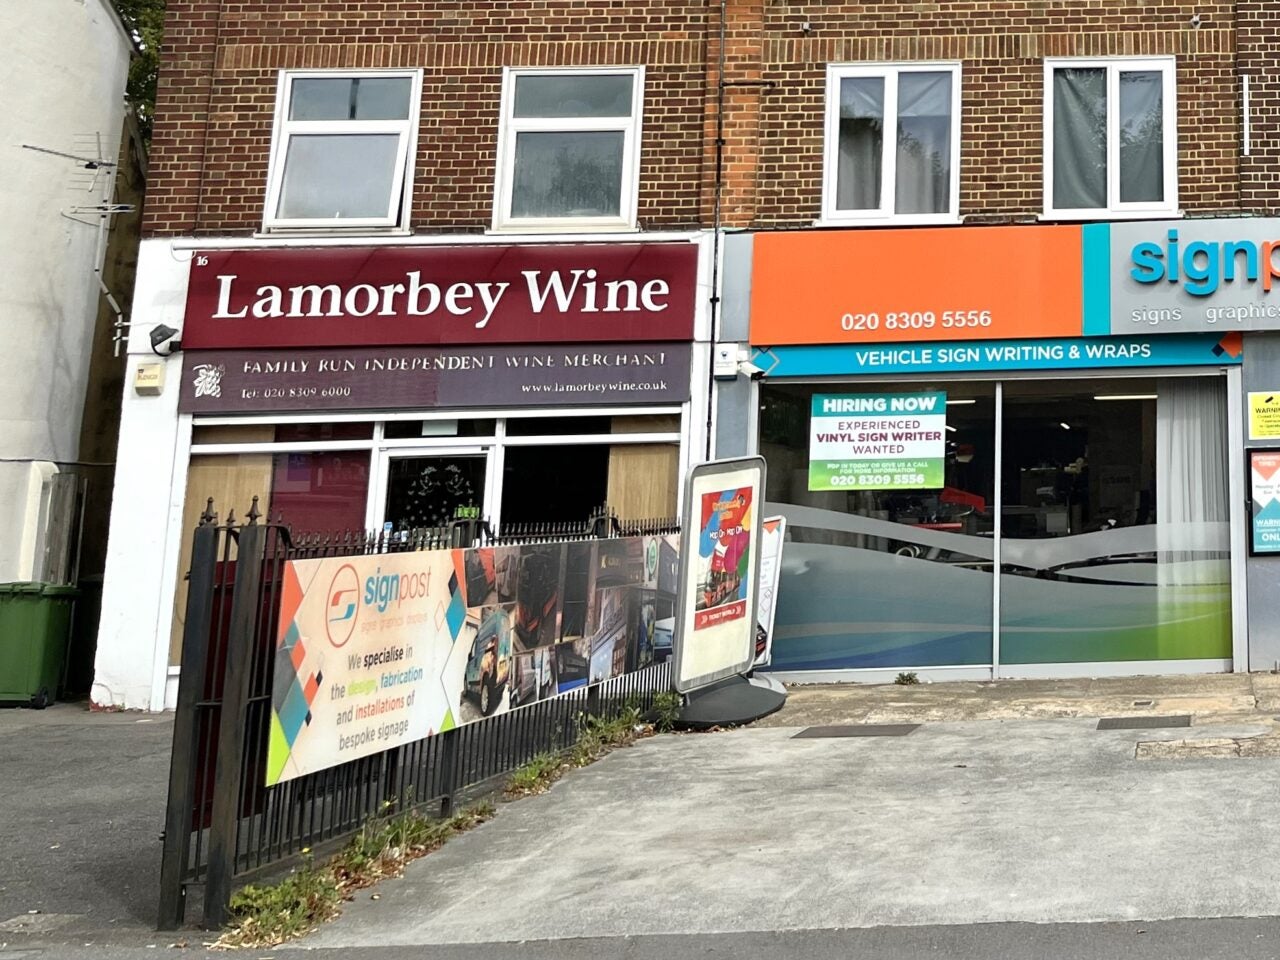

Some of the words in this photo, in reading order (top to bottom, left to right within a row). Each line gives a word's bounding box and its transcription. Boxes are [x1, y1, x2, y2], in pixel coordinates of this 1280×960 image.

[196, 256, 208, 266] 16
[212, 270, 510, 328] Lamorbey
[521, 269, 670, 313] Wine
[841, 313, 879, 330] 020
[885, 312, 936, 329] 8309
[941, 310, 992, 328] 5556
[1131, 304, 1182, 325] signs
[243, 359, 310, 373] FAMILY
[318, 358, 356, 372] RUN
[365, 354, 496, 371] INDEPENDENT
[505, 354, 555, 368] WINE
[564, 352, 666, 367] MERCHANT
[856, 348, 933, 366] VEHICLE
[937, 347, 981, 363] SIGN
[985, 345, 1065, 361] WRITING
[1069, 345, 1081, 359] &
[1085, 343, 1151, 359] WRAPS
[264, 388, 285, 398] 020
[289, 387, 316, 398] 8309
[320, 387, 351, 397] 6000
[522, 380, 667, 393] www.lamorbeywine.co.uk
[823, 398, 887, 412] HIRING
[891, 396, 937, 411] NOW
[838, 420, 920, 430] EXPERIENCED
[816, 433, 855, 442] VINYL
[858, 432, 888, 442] SIGN
[892, 431, 942, 441] WRITER
[853, 444, 905, 454] WANTED
[830, 475, 855, 486] 020
[858, 474, 891, 485] 8309
[893, 474, 925, 484] 5556
[364, 566, 432, 613] signpost
[348, 654, 361, 670] We
[363, 645, 404, 670] specialise
[405, 644, 413, 659] in
[331, 684, 345, 700] the
[380, 667, 423, 689] fabrication
[336, 705, 354, 725] and
[355, 695, 405, 720] installations
[406, 690, 416, 707] of
[339, 727, 375, 751] bespoke
[377, 719, 409, 740] signage
